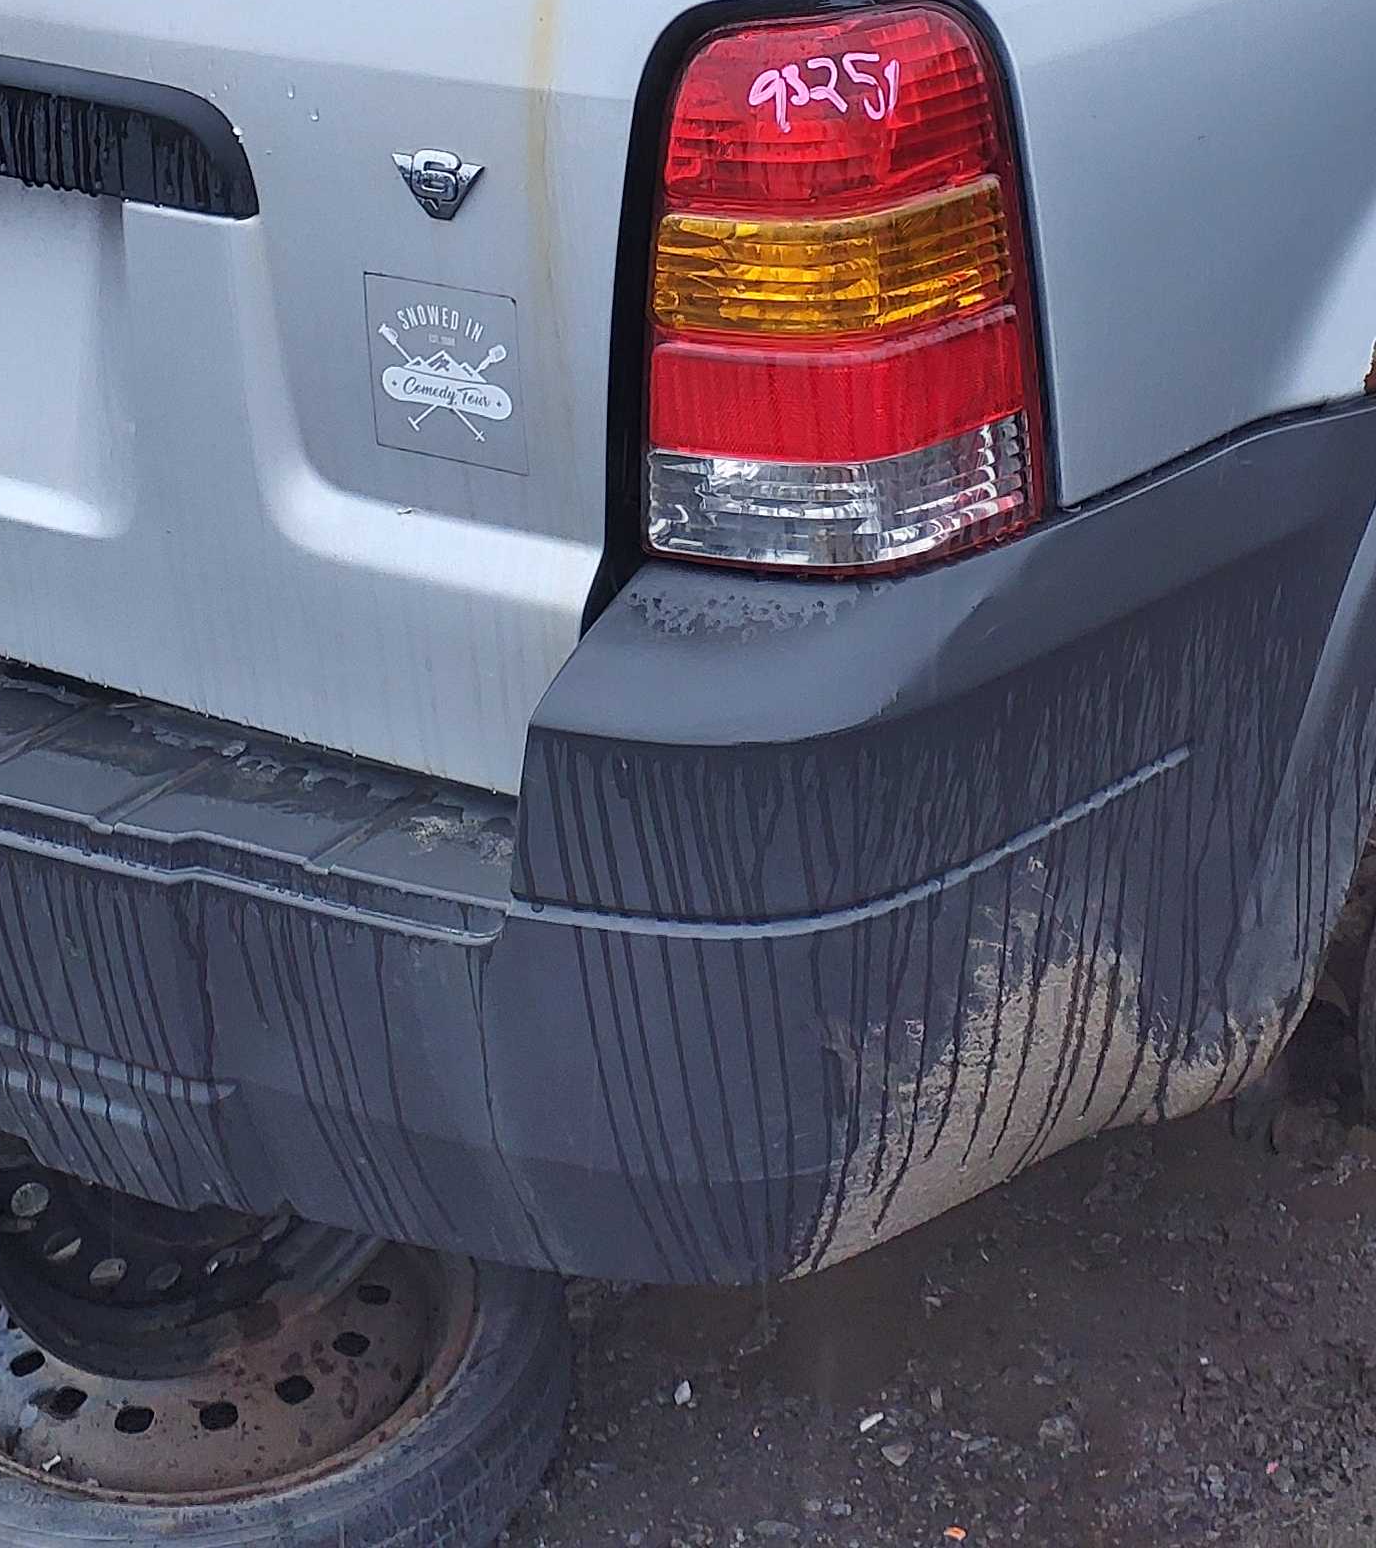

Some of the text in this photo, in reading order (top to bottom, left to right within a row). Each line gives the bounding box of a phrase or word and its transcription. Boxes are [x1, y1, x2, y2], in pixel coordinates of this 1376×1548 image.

[747, 51, 901, 134] 93251
[396, 304, 460, 330] SNOWED
[464, 317, 484, 343] IN
[403, 376, 490, 407] Comedy Tour
